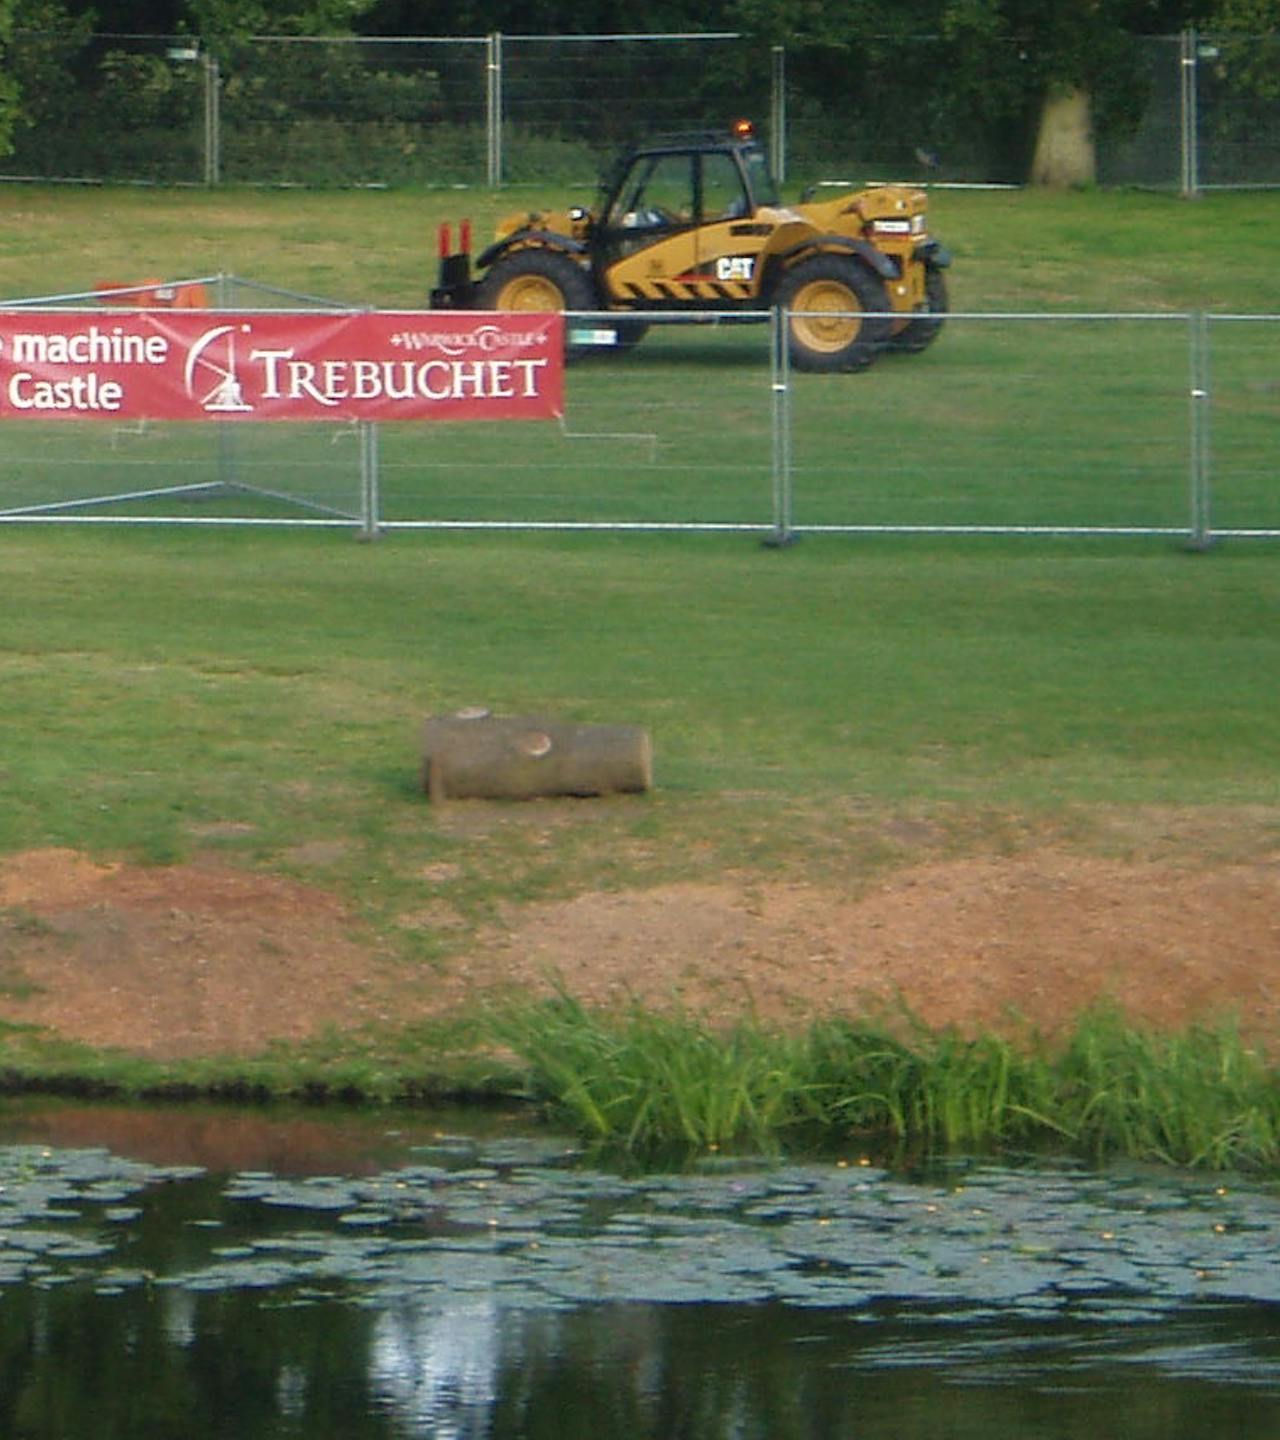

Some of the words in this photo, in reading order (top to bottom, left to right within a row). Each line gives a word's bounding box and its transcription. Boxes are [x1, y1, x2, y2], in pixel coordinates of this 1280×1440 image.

[716, 257, 754, 280] CAT
[12, 328, 168, 364] machine
[8, 373, 123, 410] Castle
[249, 348, 548, 406] TREBUCHET
